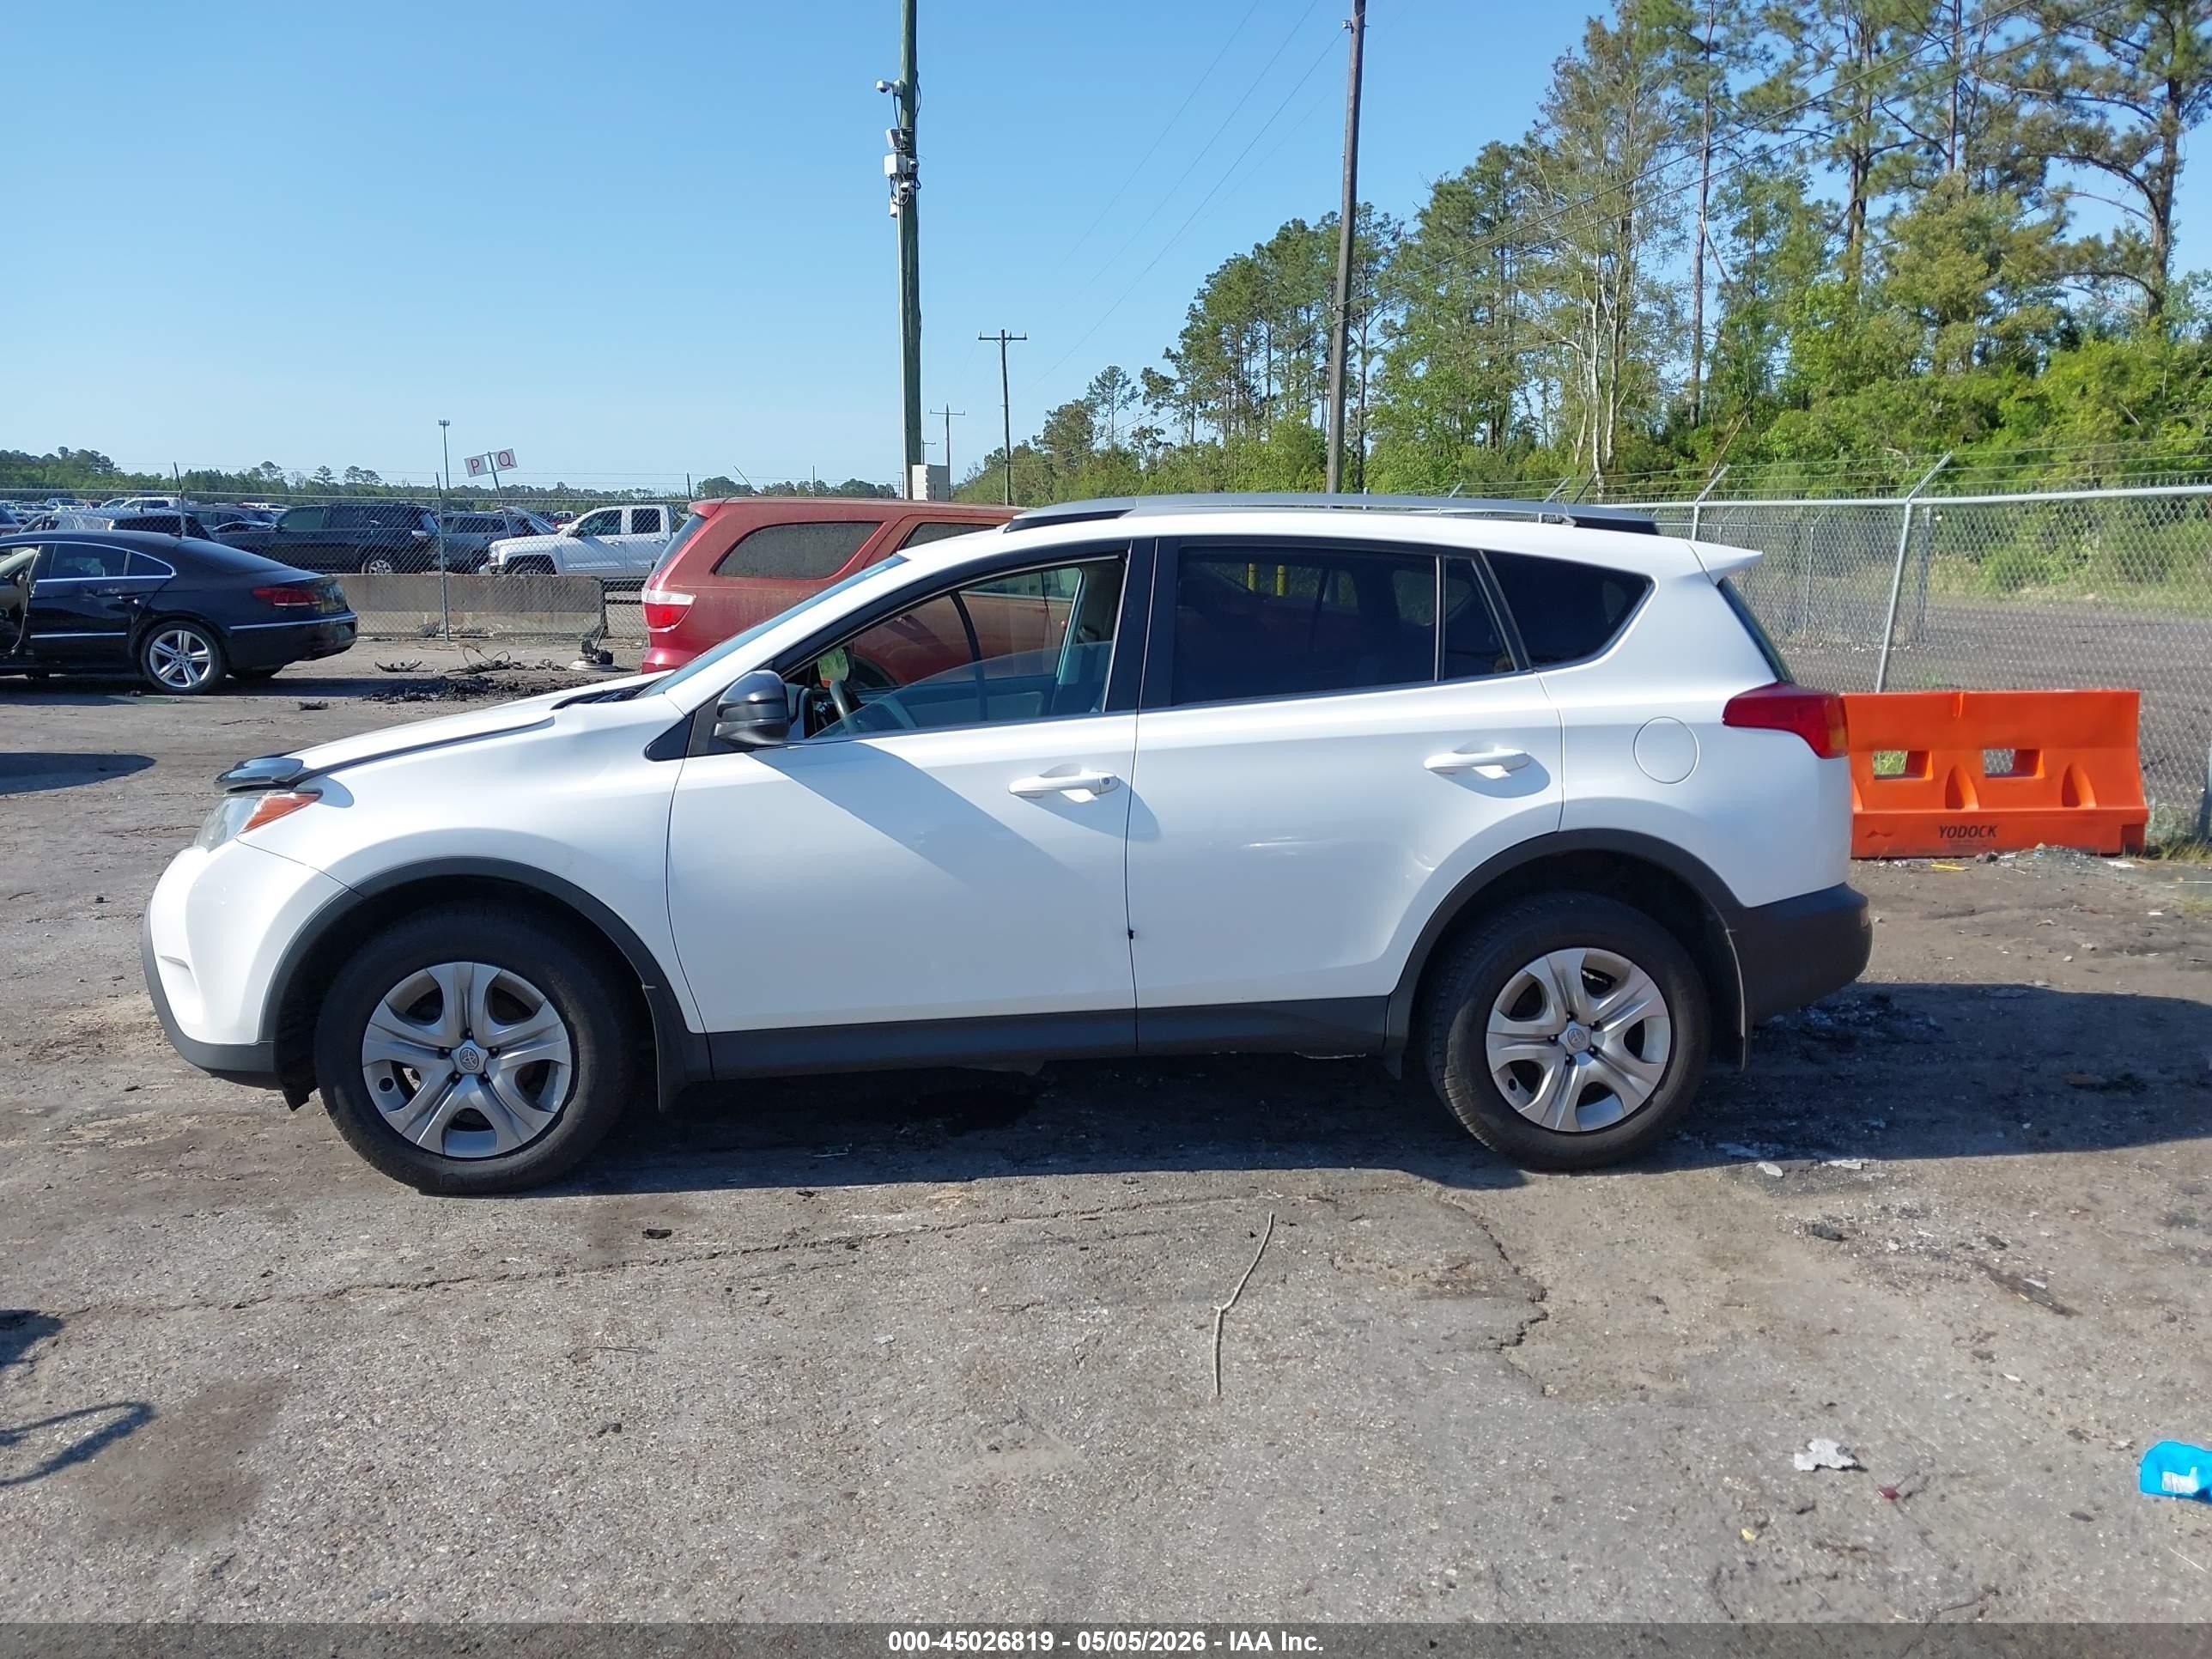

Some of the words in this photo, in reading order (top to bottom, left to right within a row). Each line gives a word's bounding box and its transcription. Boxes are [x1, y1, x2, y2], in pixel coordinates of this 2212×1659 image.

[471, 459, 480, 474] P
[498, 451, 514, 467] Q
[1939, 824, 1998, 839] YODOCK
